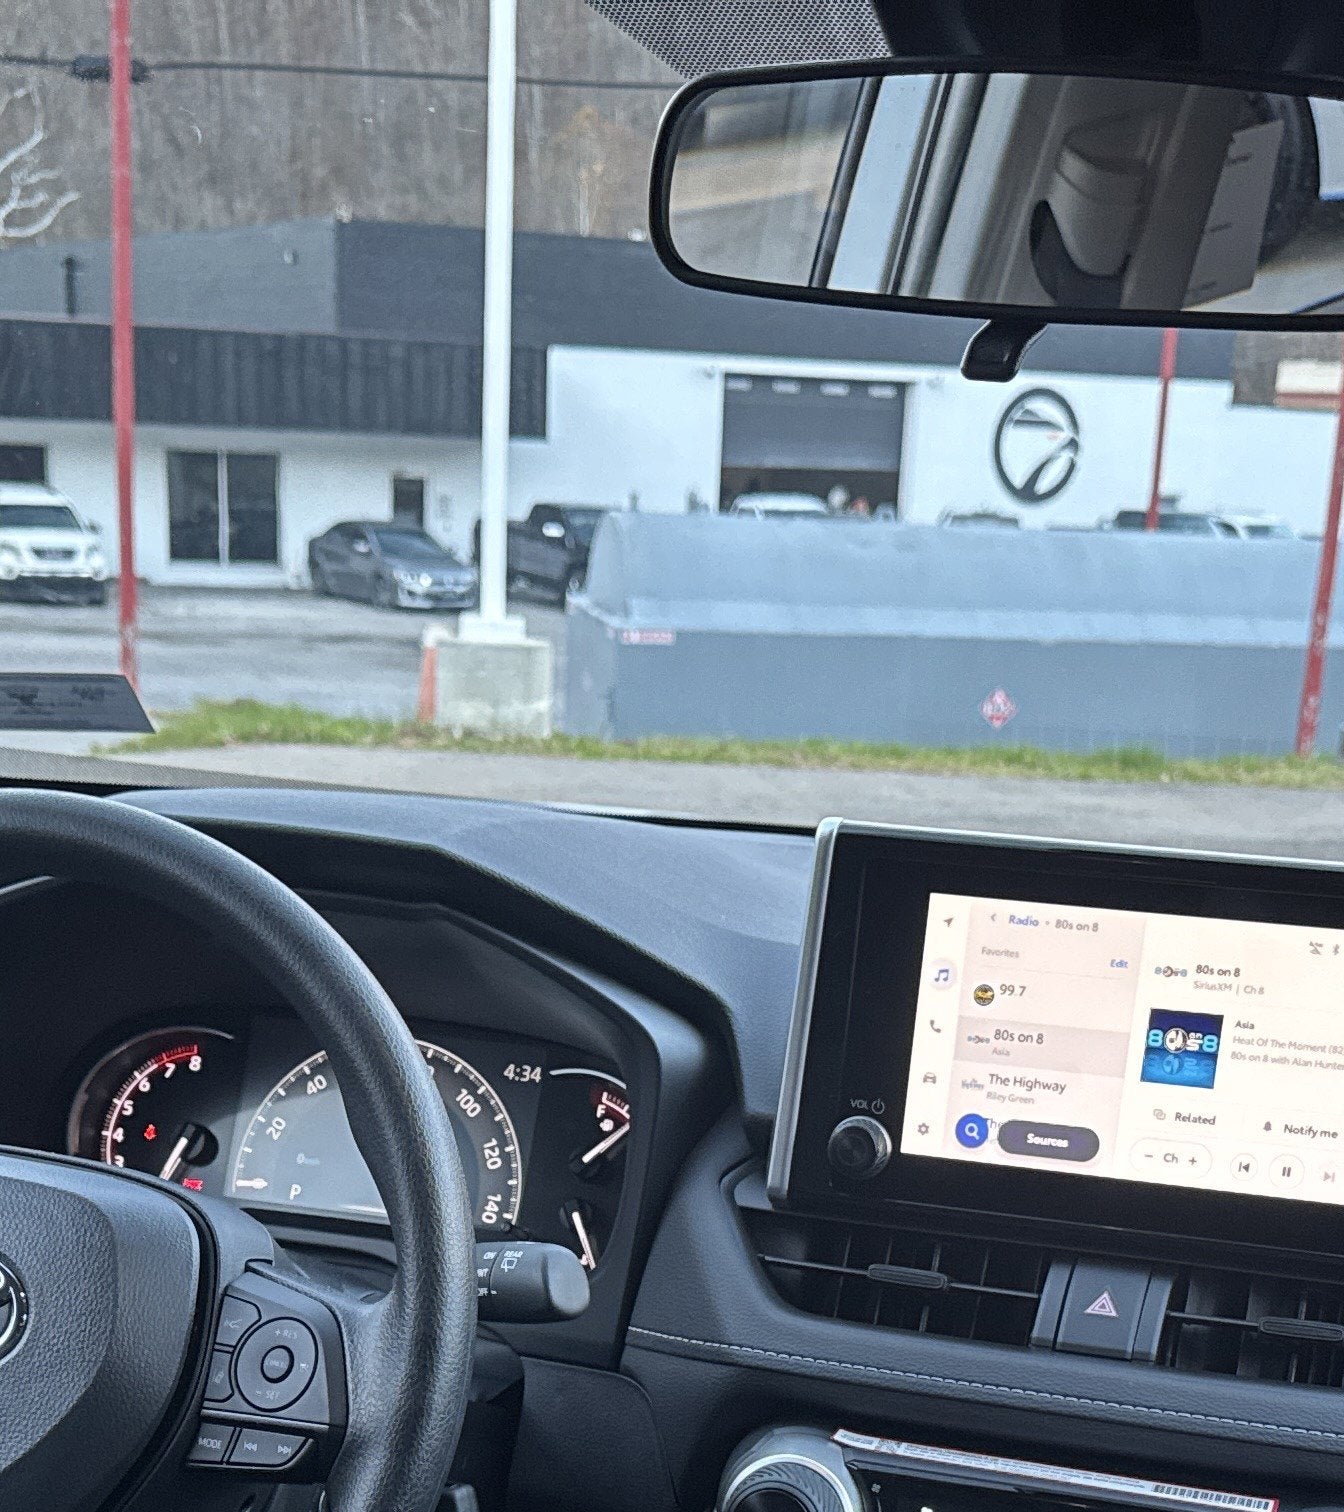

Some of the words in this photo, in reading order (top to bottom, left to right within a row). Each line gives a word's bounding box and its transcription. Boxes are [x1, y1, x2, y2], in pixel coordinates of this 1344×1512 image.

[1008, 915, 1040, 928] Radio
[1055, 919, 1074, 931] 80s
[1076, 923, 1090, 932] on
[1091, 922, 1099, 932] 8
[981, 946, 1020, 959] Favorites
[1110, 959, 1129, 969] Edit
[1196, 964, 1214, 976] 80s
[1217, 968, 1231, 977] on
[1233, 967, 1241, 977] 8
[999, 984, 1027, 997] 99.7
[1193, 980, 1233, 992] SiriusXM
[1243, 985, 1256, 995] Ch
[1257, 986, 1265, 995] 8
[1235, 1019, 1255, 1031] Asia
[994, 1029, 1015, 1043] 80s
[1018, 1032, 1034, 1044] on
[1036, 1032, 1044, 1045] 8
[1233, 1035, 1255, 1047] Heat
[1256, 1037, 1269, 1048] Of
[1271, 1039, 1287, 1050] The
[1288, 1040, 1328, 1054] Moment
[992, 1046, 1011, 1057] Asia
[1230, 1051, 1247, 1061] 80s
[1248, 1053, 1261, 1062] on
[1262, 1054, 1269, 1063] 8
[1270, 1053, 1290, 1065] with
[1292, 1056, 1313, 1068] Alan
[164, 1063, 176, 1079] 7
[188, 1055, 202, 1072] 8
[503, 1062, 542, 1083] 4:34
[138, 1077, 151, 1093] 6
[306, 1074, 328, 1095] 40
[988, 1073, 1011, 1088] The
[1013, 1076, 1066, 1095] Highway
[455, 1088, 482, 1118] 100
[849, 1098, 870, 1110] VOL
[986, 1090, 1006, 1104] Riley
[1008, 1093, 1035, 1105] Green
[121, 1099, 134, 1116] 5
[596, 1104, 606, 1119] F
[1174, 1112, 1216, 1126] Related
[112, 1127, 124, 1143] 4
[266, 1116, 286, 1141] 20
[1284, 1123, 1319, 1140] Notify
[1320, 1128, 1339, 1139] me
[1026, 1132, 1069, 1148] Sources
[483, 1137, 502, 1170] 120
[1163, 1152, 1179, 1164] Ch
[289, 1183, 302, 1200] P
[481, 1193, 502, 1224] 140
[503, 1250, 524, 1259] REAR
[198, 1437, 223, 1450] MODE
